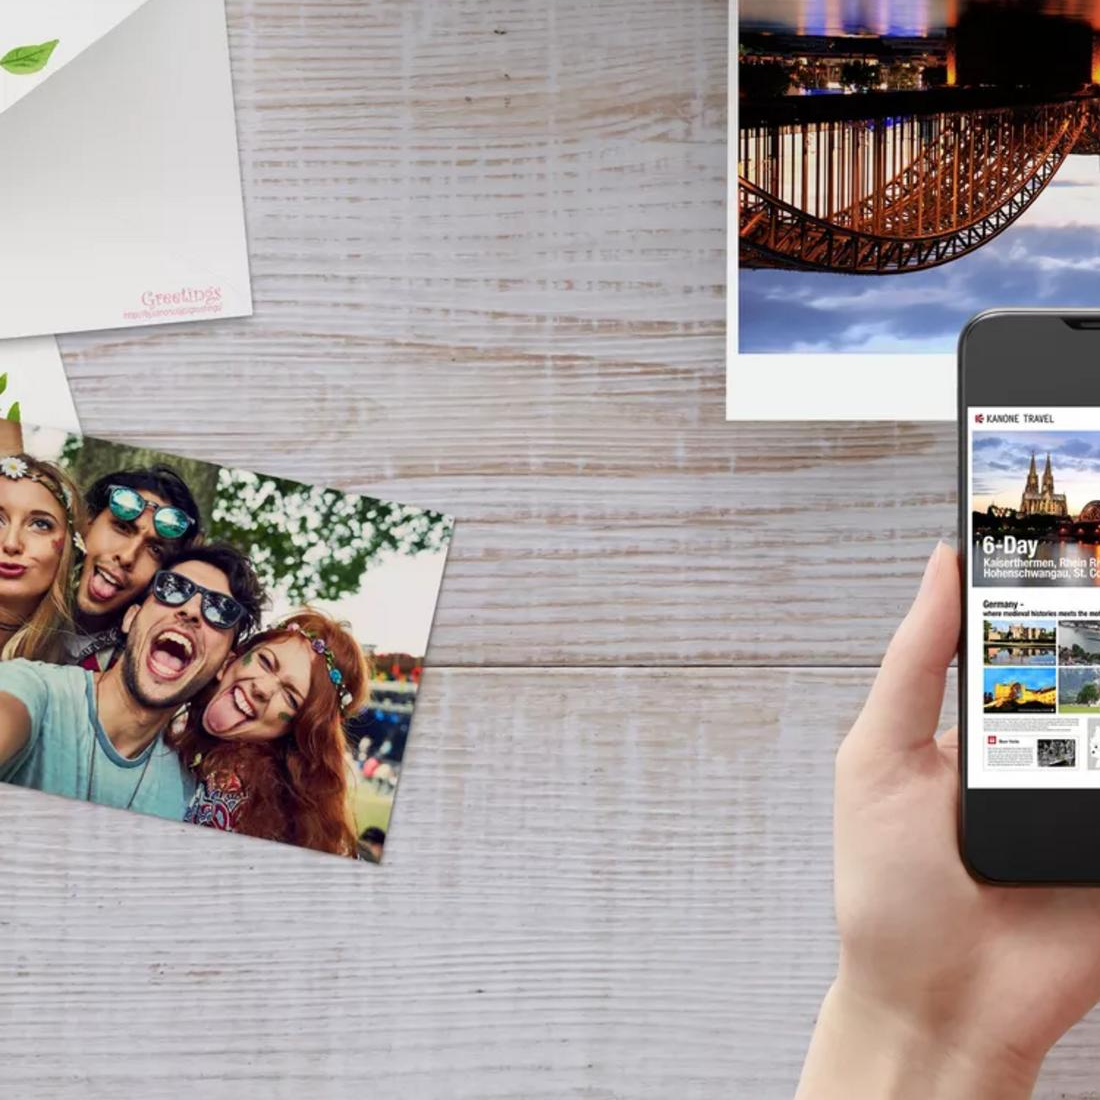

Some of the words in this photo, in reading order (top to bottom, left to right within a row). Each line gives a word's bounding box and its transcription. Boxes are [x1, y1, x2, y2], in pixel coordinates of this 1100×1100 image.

[141, 286, 222, 307] Greetings
[986, 414, 1019, 423] KANONE
[1023, 414, 1055, 423] TRAVEL
[982, 535, 1039, 558] 6-Day
[983, 599, 1018, 609] Germany
